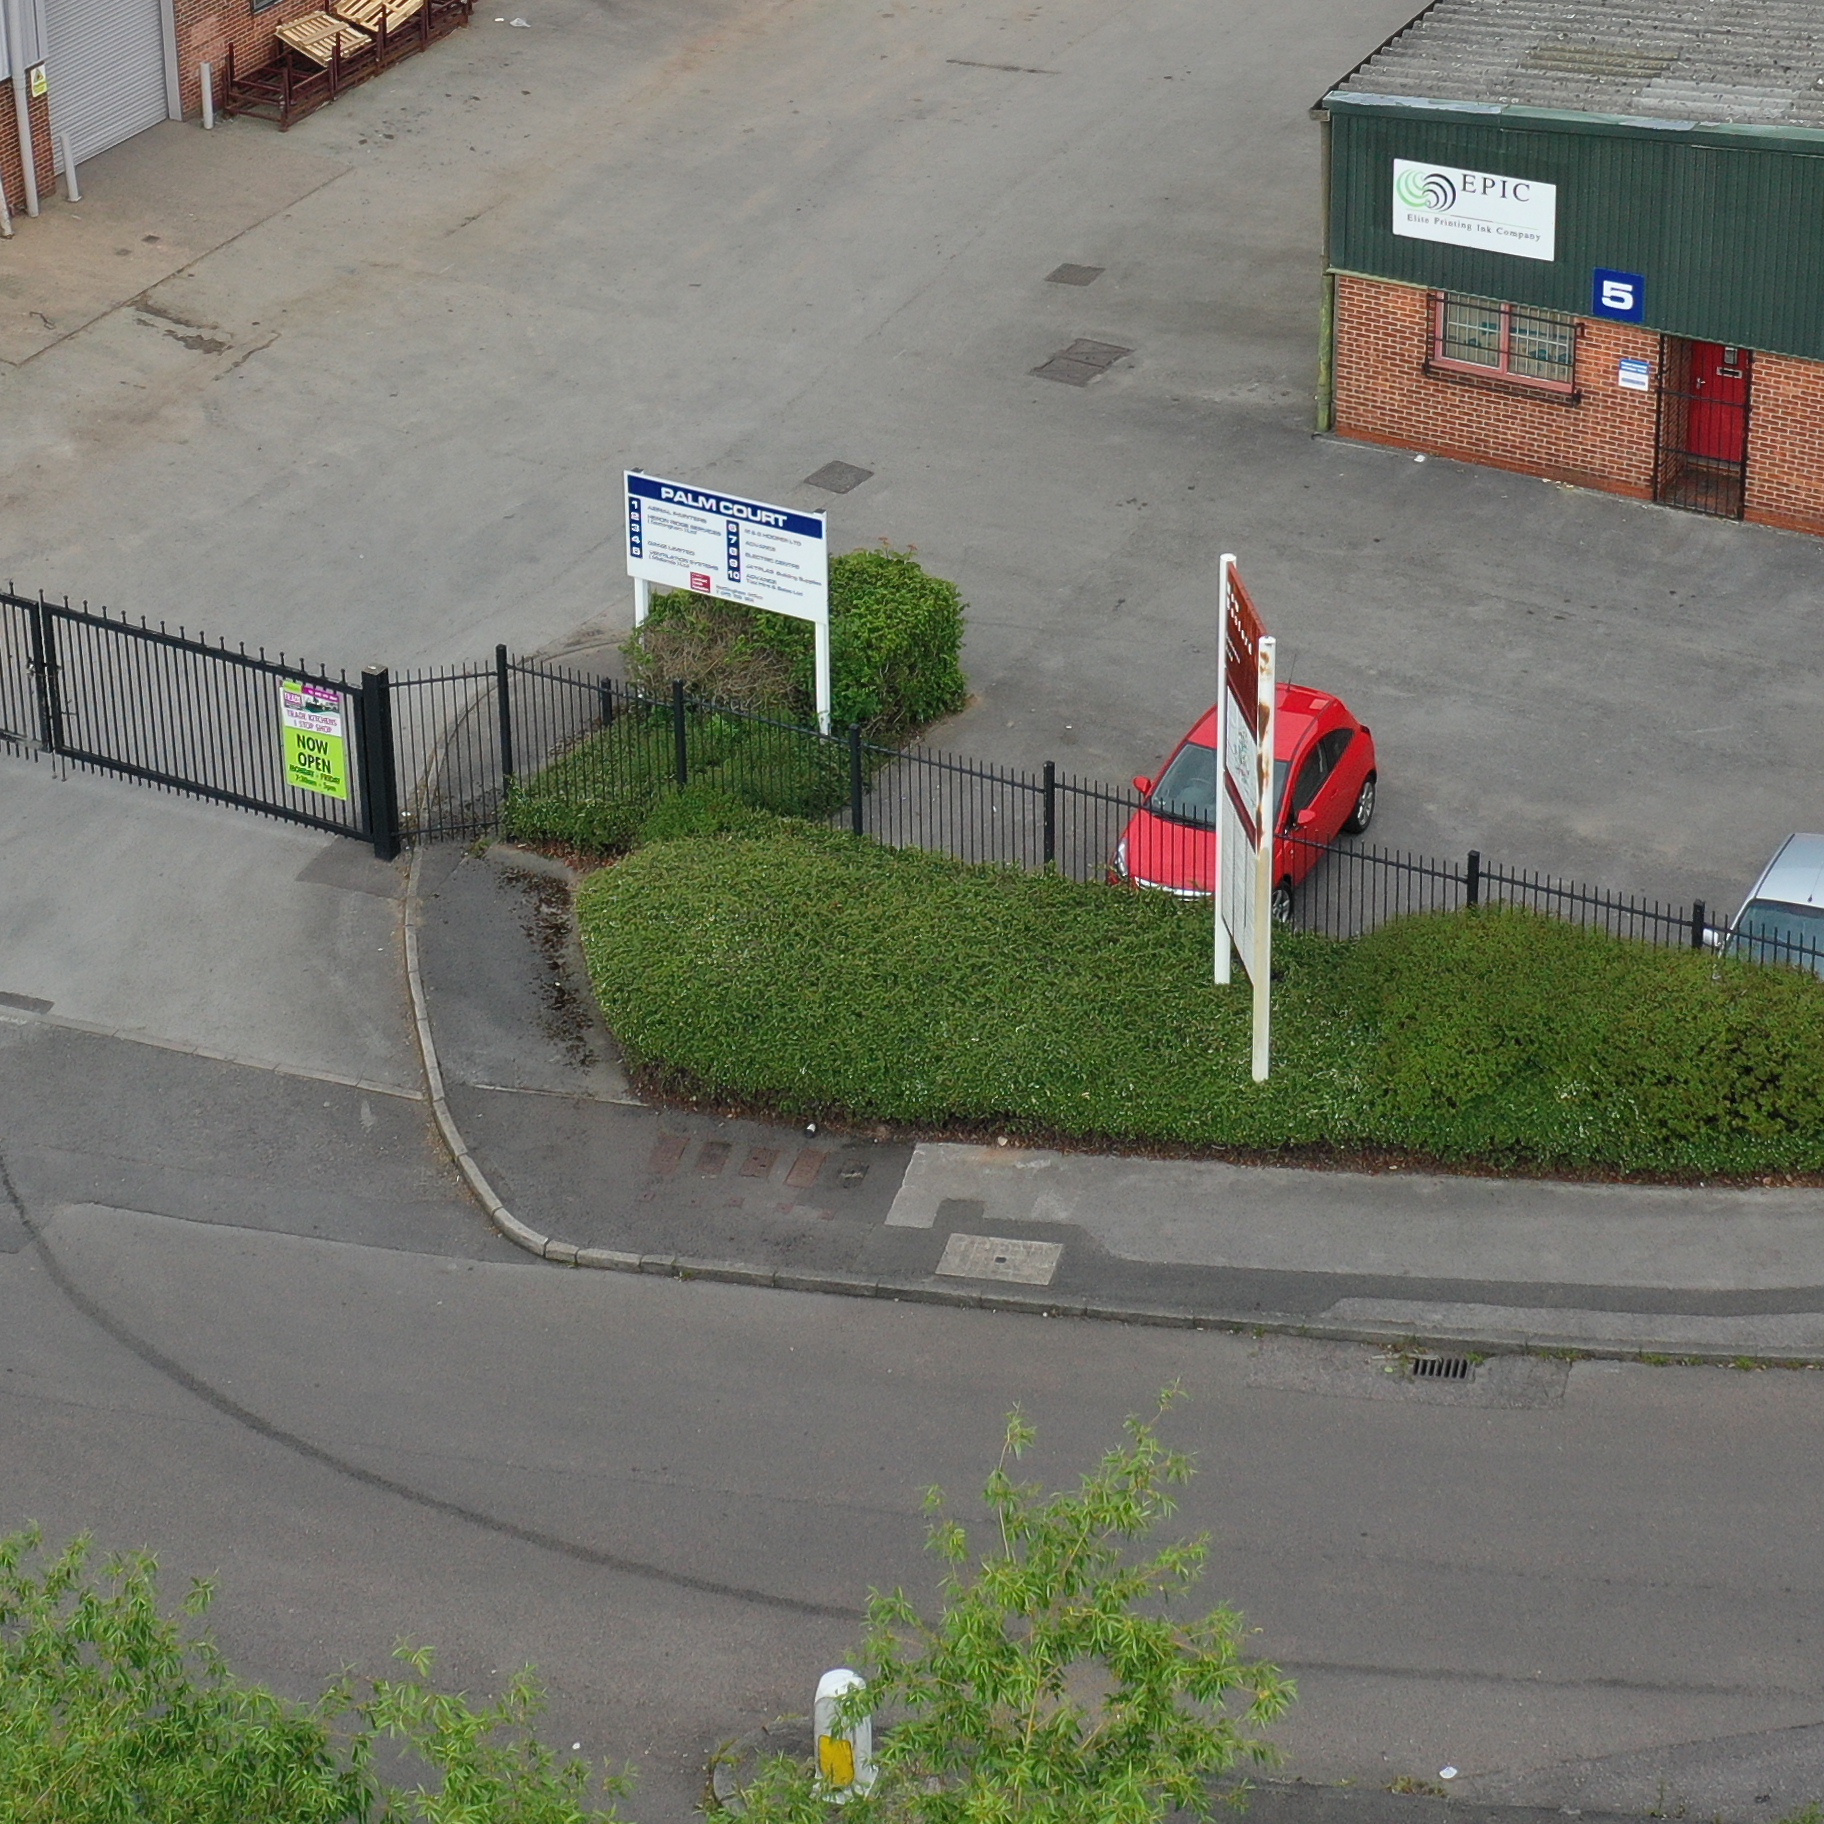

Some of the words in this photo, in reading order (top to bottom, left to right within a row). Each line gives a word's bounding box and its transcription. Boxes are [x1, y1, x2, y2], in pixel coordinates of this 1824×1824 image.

[1461, 173, 1531, 202] EPIC
[1407, 214, 1430, 224] Elite
[1434, 217, 1472, 232] Printing
[1477, 223, 1492, 234] Ink
[1496, 227, 1542, 242] Company
[1601, 280, 1634, 310] 5
[631, 500, 638, 509] 1
[661, 487, 716, 511] PALM
[719, 501, 787, 527] COURT
[631, 512, 639, 521] 2
[631, 523, 640, 532] 3
[728, 524, 736, 532] 6
[631, 536, 640, 544] 4
[728, 535, 737, 544] 7
[729, 547, 737, 555] 8
[729, 559, 738, 567] 9
[728, 570, 740, 580] 10
[297, 734, 328, 755] NOW
[298, 752, 331, 774] OPEN
